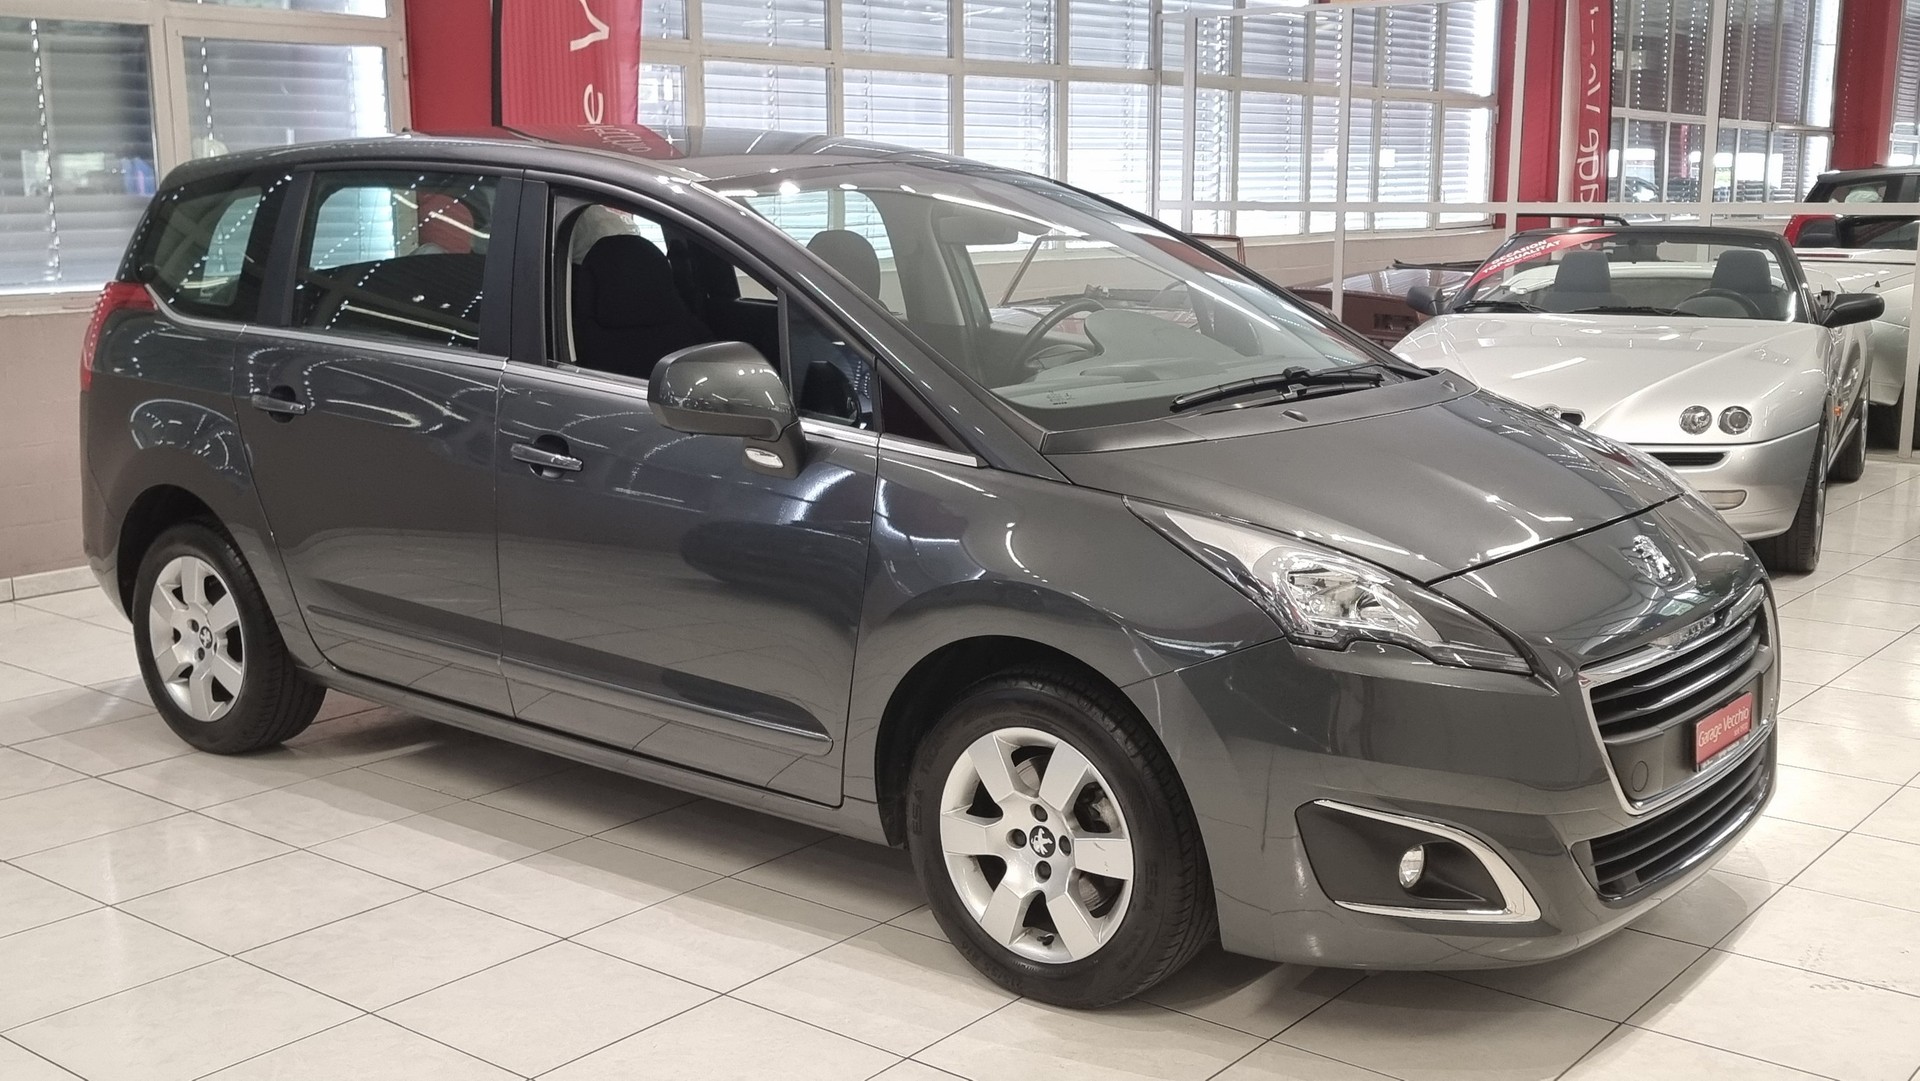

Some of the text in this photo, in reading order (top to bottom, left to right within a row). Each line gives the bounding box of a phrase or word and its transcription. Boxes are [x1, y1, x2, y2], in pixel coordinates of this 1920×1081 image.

[1491, 239, 1547, 265] OCCASION
[1698, 723, 1722, 747] Garage
[1723, 706, 1749, 732] Vecchio
